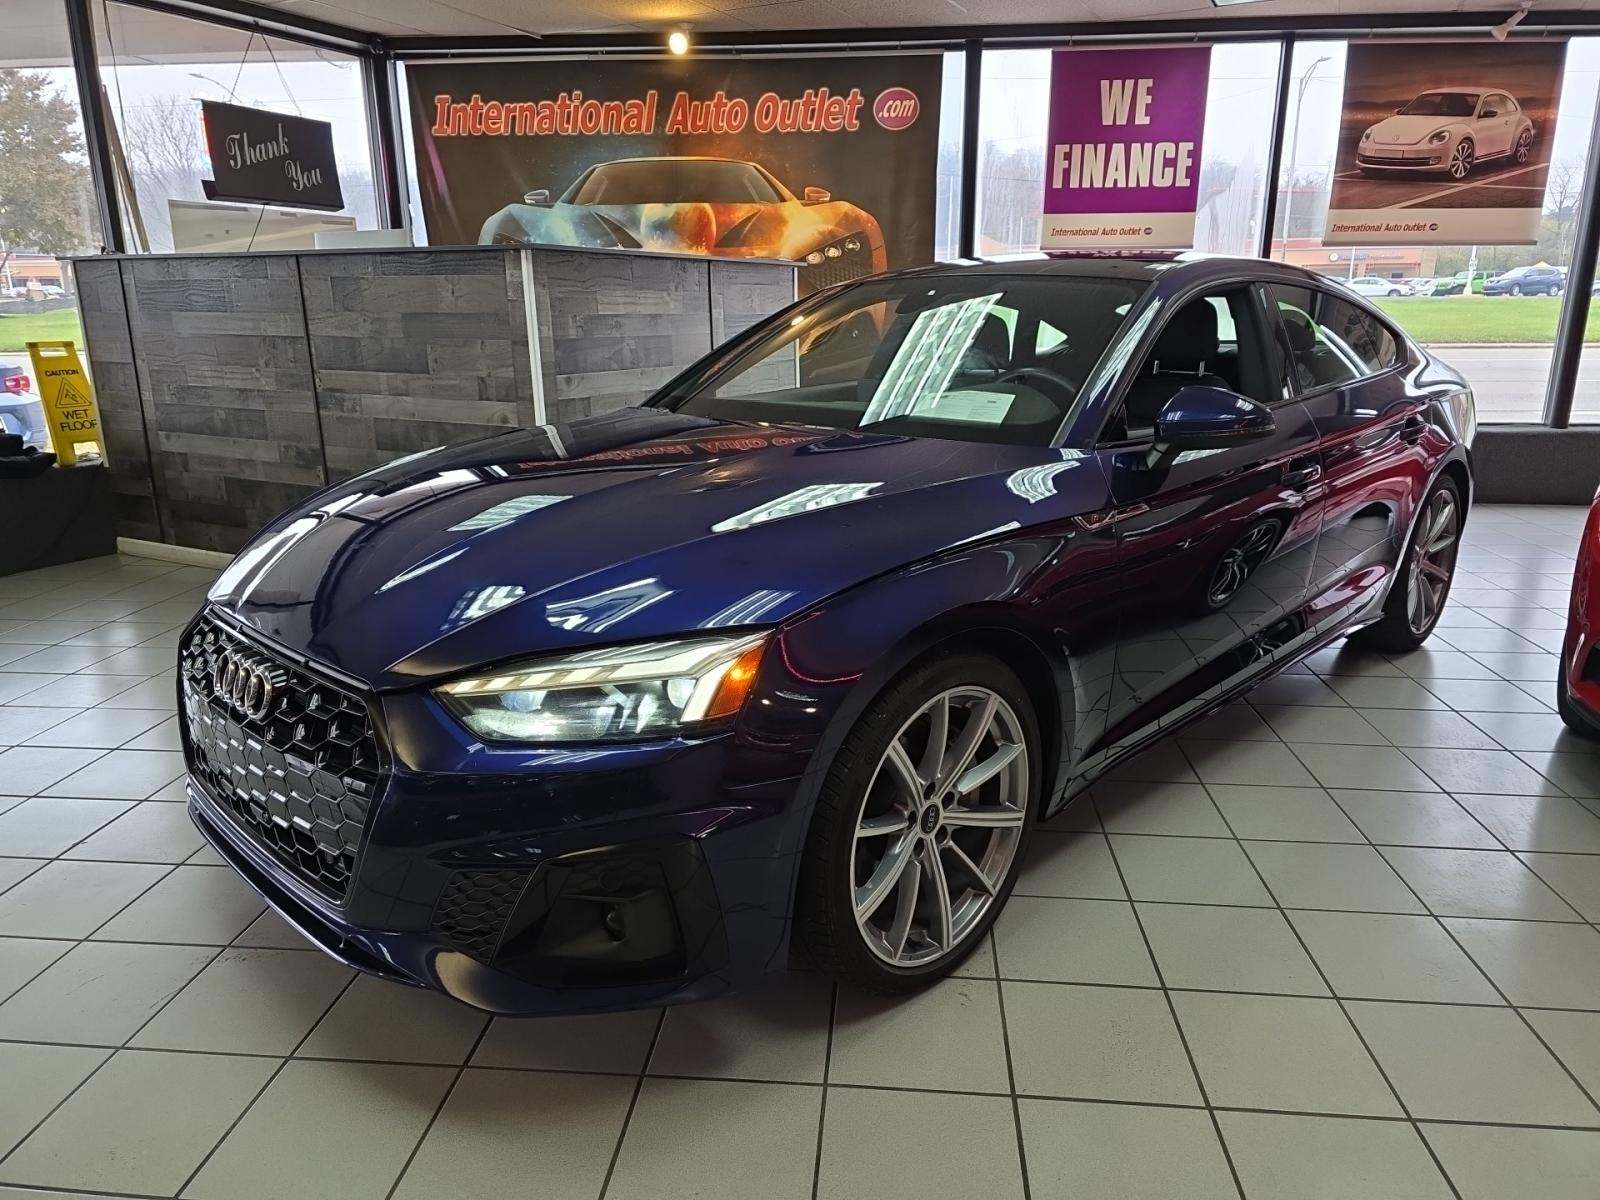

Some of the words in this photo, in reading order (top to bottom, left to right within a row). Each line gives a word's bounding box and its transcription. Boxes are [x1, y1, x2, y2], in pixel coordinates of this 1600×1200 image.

[432, 90, 657, 136] International
[666, 91, 748, 135] Auto
[754, 87, 865, 133] Outlet
[878, 98, 915, 118] .com
[1100, 78, 1153, 126] WE
[225, 123, 289, 169] Thank
[284, 159, 323, 191] You
[1052, 141, 1194, 189] FINANCE
[1051, 227, 1100, 237] International
[1101, 227, 1118, 236] Auto
[1119, 226, 1141, 236] Outlet
[1331, 223, 1382, 232] International
[1384, 223, 1402, 232] Auto
[1403, 222, 1427, 232] Outlet
[45, 369, 79, 377] CAUTION
[62, 409, 88, 420] WET
